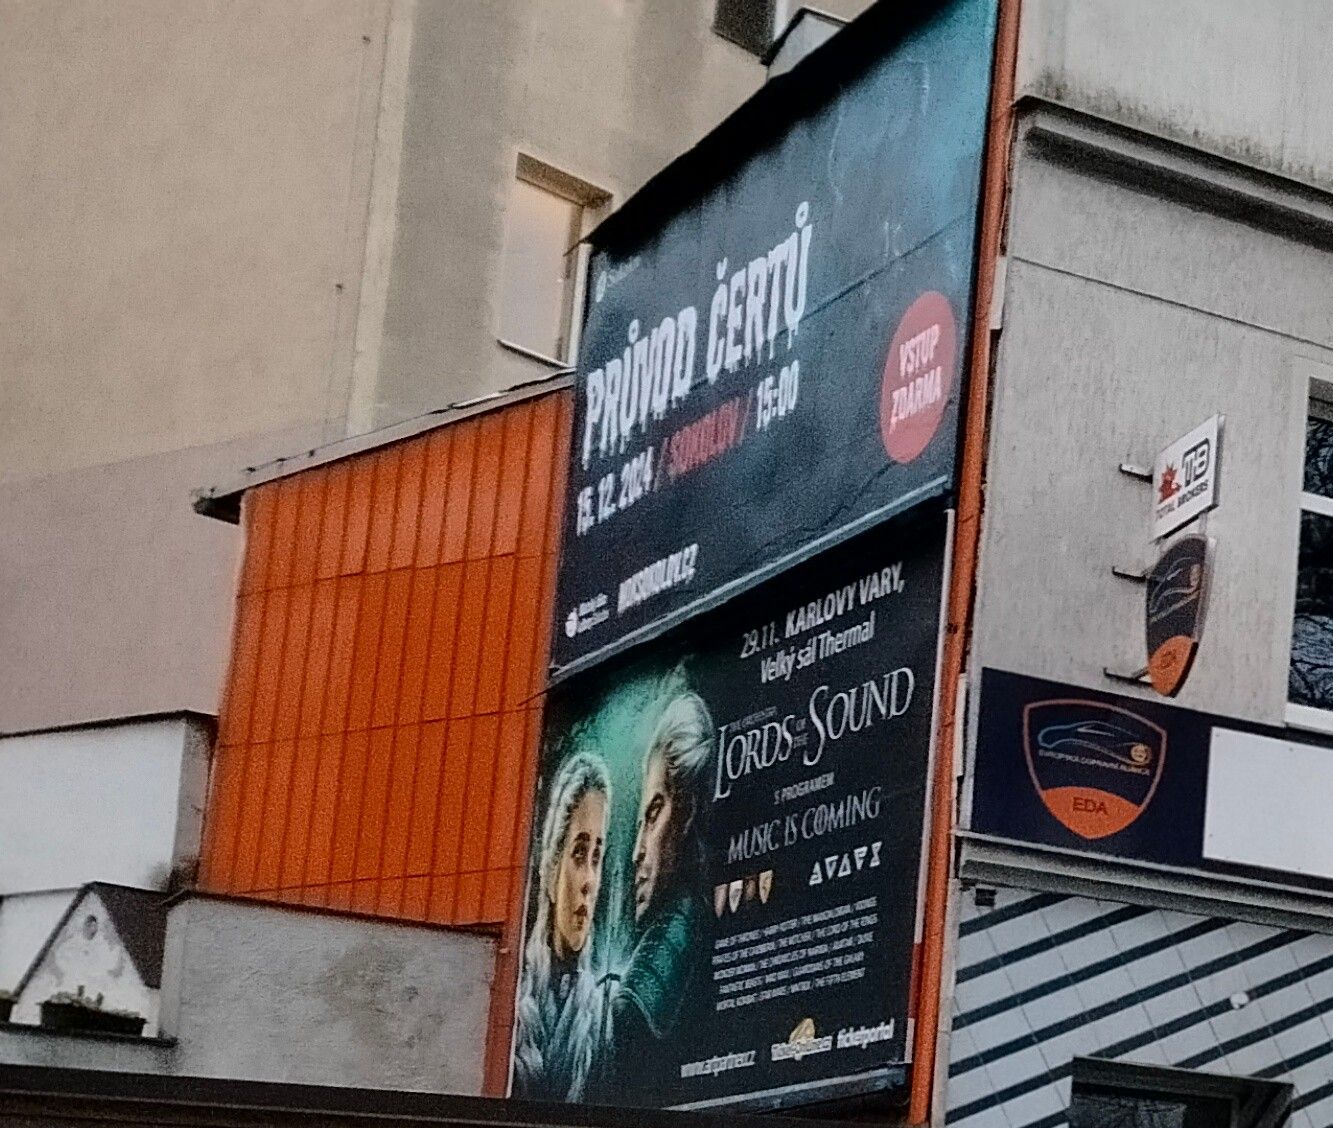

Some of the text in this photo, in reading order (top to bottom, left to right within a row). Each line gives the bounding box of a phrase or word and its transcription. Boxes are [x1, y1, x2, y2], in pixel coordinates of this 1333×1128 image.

[582, 201, 813, 470] PRŮVOD ČERTŮ
[900, 324, 940, 378] VSTUP
[757, 360, 799, 432] 15:00
[889, 366, 942, 434] ZDARMA
[740, 561, 905, 659] 29.11. KARLOVY VARY,
[761, 610, 876, 683] Velký sál Thermal
[712, 714, 795, 803] LORDS
[803, 667, 915, 766] SOUND
[728, 787, 882, 864] MUSIC IS COMING
[1072, 796, 1109, 816] EDA
